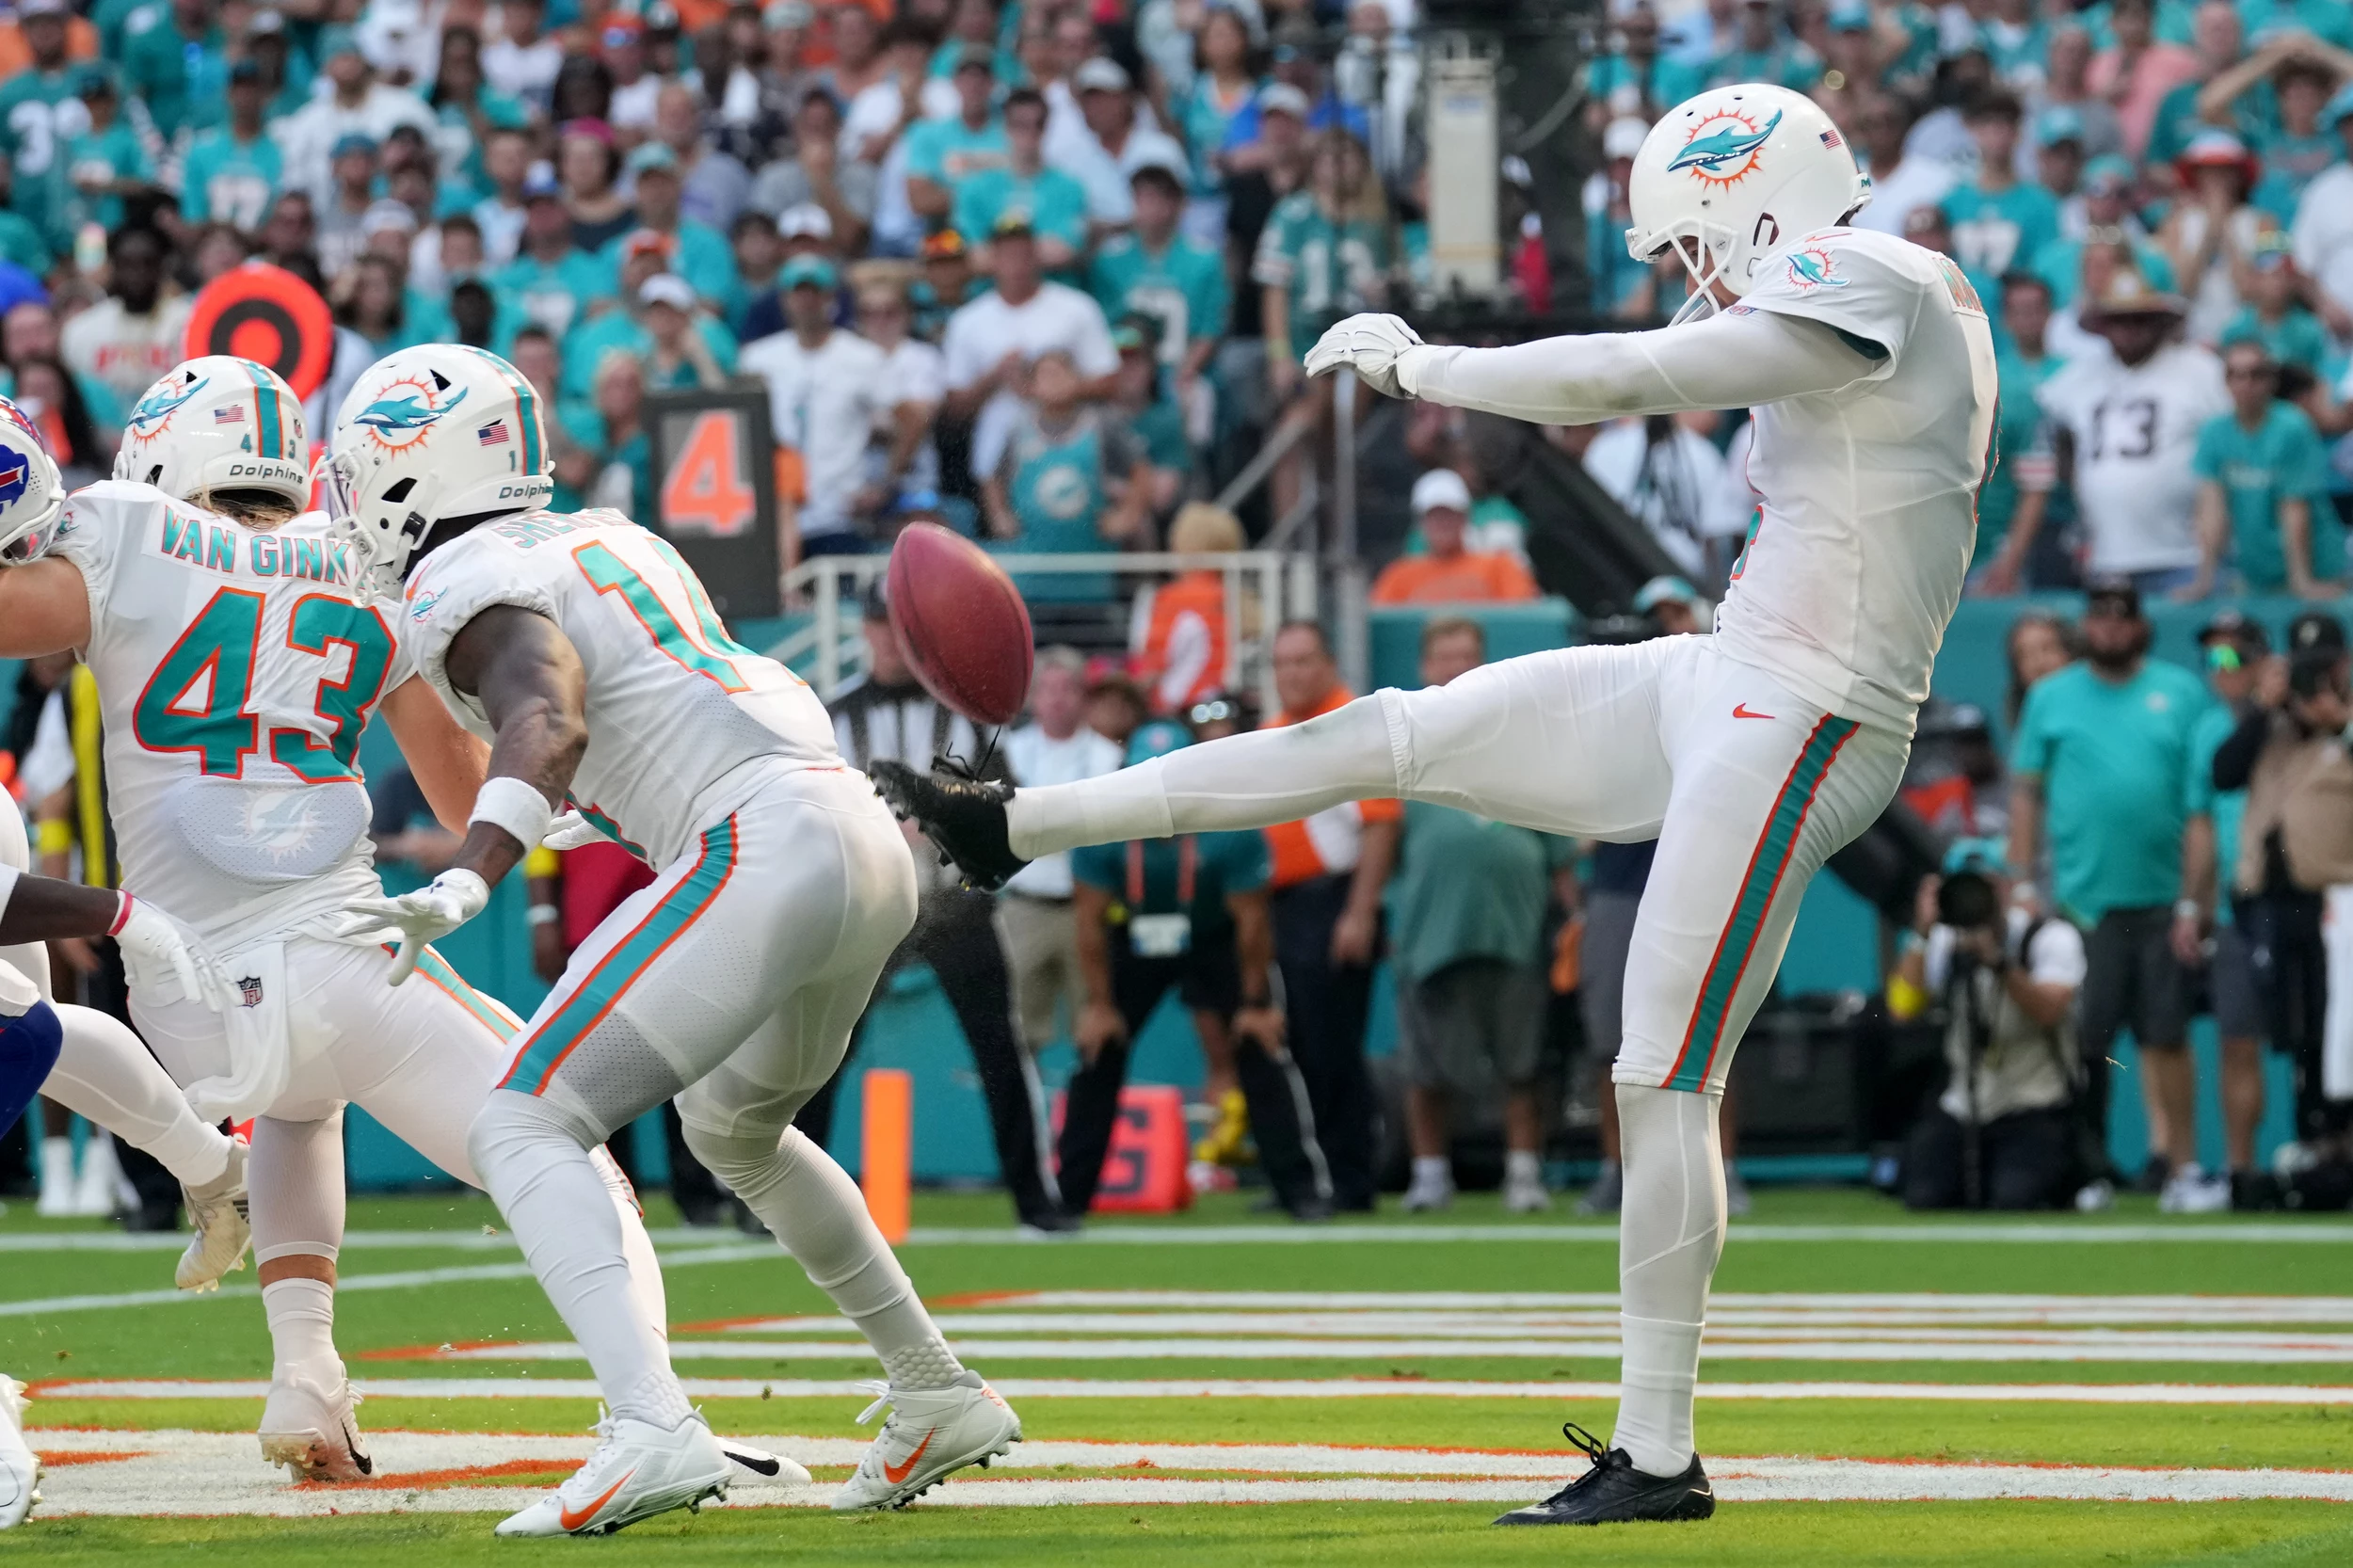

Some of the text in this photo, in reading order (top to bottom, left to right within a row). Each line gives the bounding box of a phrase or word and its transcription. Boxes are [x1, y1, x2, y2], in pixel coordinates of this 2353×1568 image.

[240, 433, 296, 459] 4 3
[509, 450, 516, 472] 1
[662, 408, 757, 535] 4
[229, 464, 304, 485] Dolphins
[498, 482, 554, 499] Dolph
[161, 504, 377, 590] VAN GINK
[132, 585, 398, 785] 43
